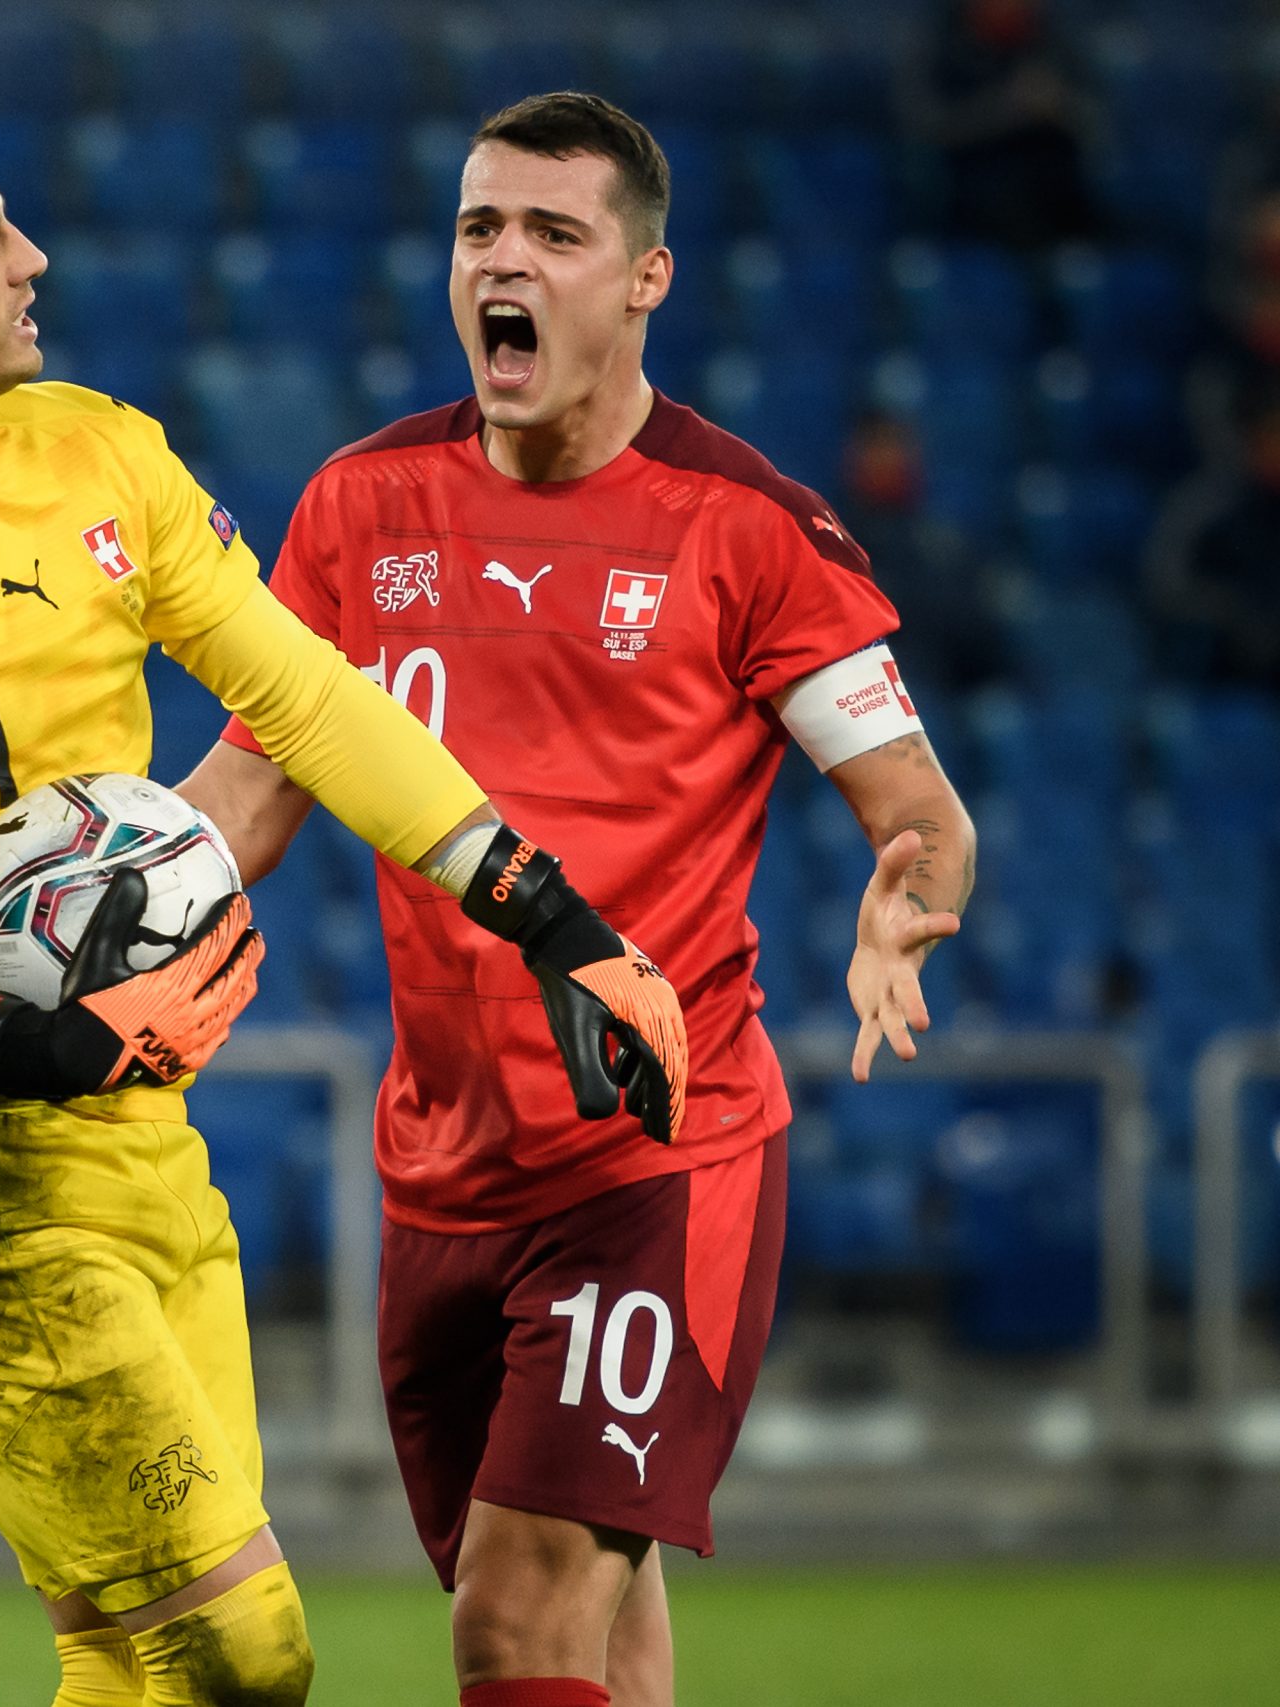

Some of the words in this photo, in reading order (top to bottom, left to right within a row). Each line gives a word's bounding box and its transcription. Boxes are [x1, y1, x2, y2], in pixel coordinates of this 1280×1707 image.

[602, 638, 621, 650] SUI
[629, 639, 648, 651] ESP
[610, 650, 637, 661] BASEL
[836, 681, 888, 709] SCHWEIZ
[849, 694, 890, 718] SUISSE
[492, 841, 540, 902] ERANO
[550, 1282, 674, 1415] 10
